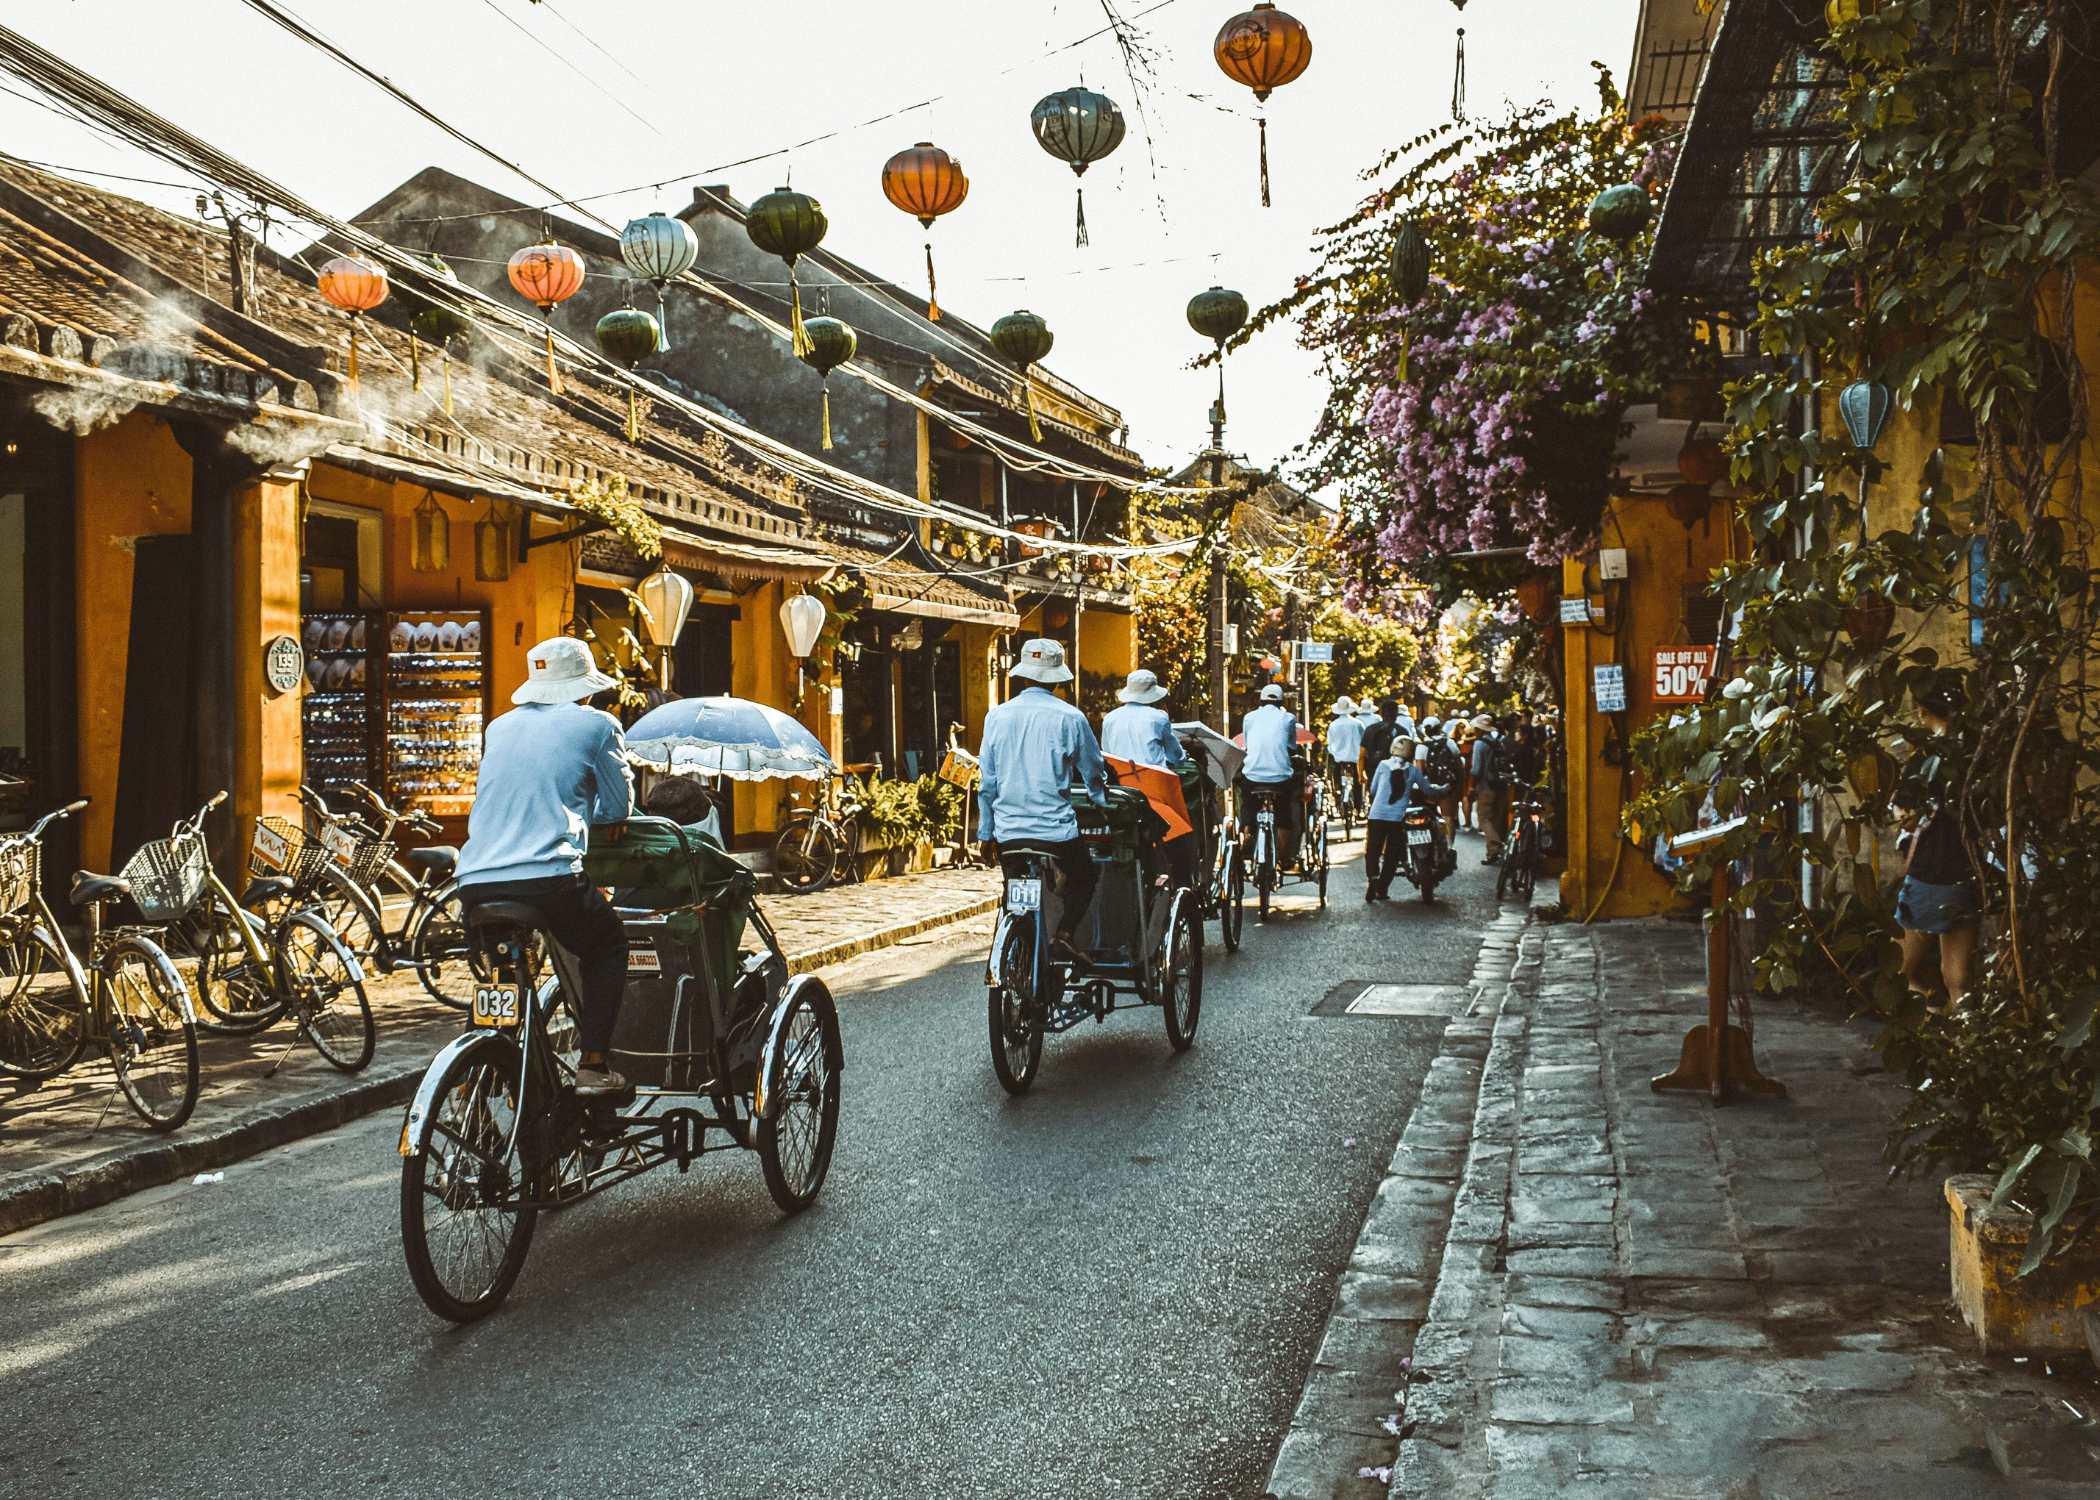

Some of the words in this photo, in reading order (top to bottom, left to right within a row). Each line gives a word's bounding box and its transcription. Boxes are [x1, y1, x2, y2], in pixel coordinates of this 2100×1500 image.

[1656, 651, 1675, 664] SALE
[1677, 651, 1691, 664] OFF
[1694, 651, 1707, 664] ALL
[1656, 665, 1707, 696] 50%
[1011, 886, 1036, 903] 011
[477, 989, 515, 1016] 032
